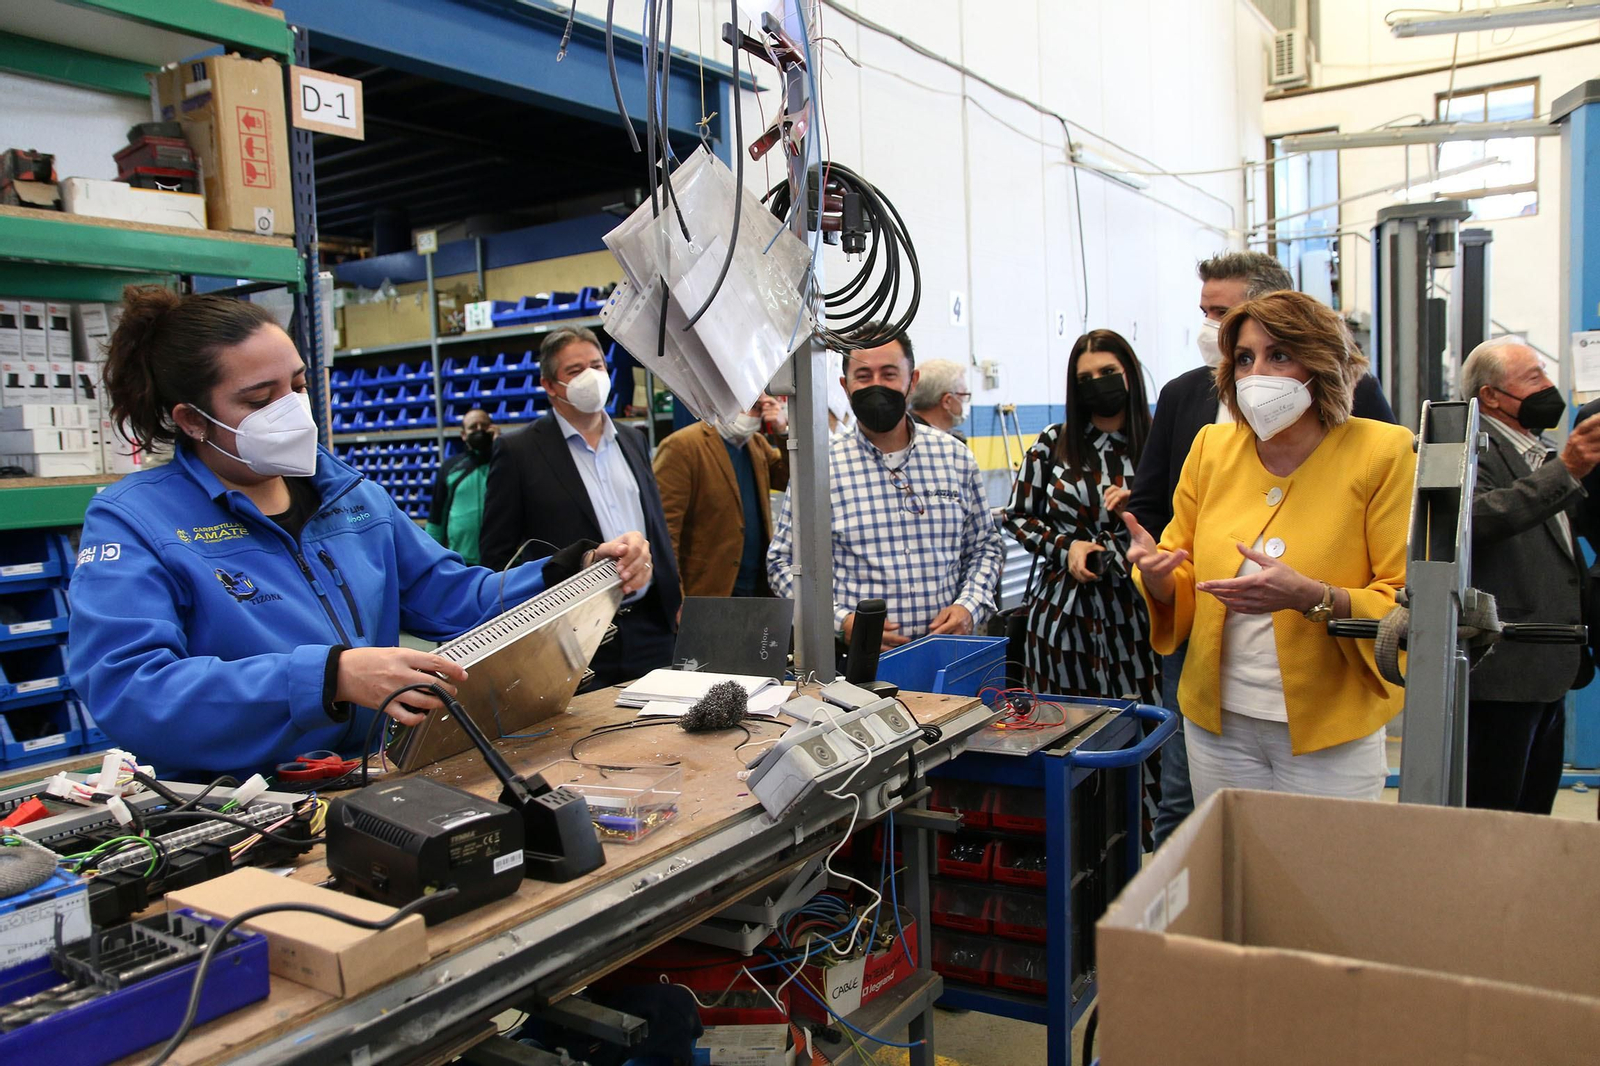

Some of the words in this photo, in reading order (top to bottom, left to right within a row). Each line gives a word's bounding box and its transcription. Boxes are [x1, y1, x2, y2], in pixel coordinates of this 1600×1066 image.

[301, 84, 351, 120] D-1
[953, 297, 960, 322] 4
[1057, 314, 1064, 336] 3
[194, 527, 250, 541] AMATE
[250, 593, 283, 605] TIZONA
[832, 977, 858, 999] CABLE
[869, 970, 895, 992] legrand
